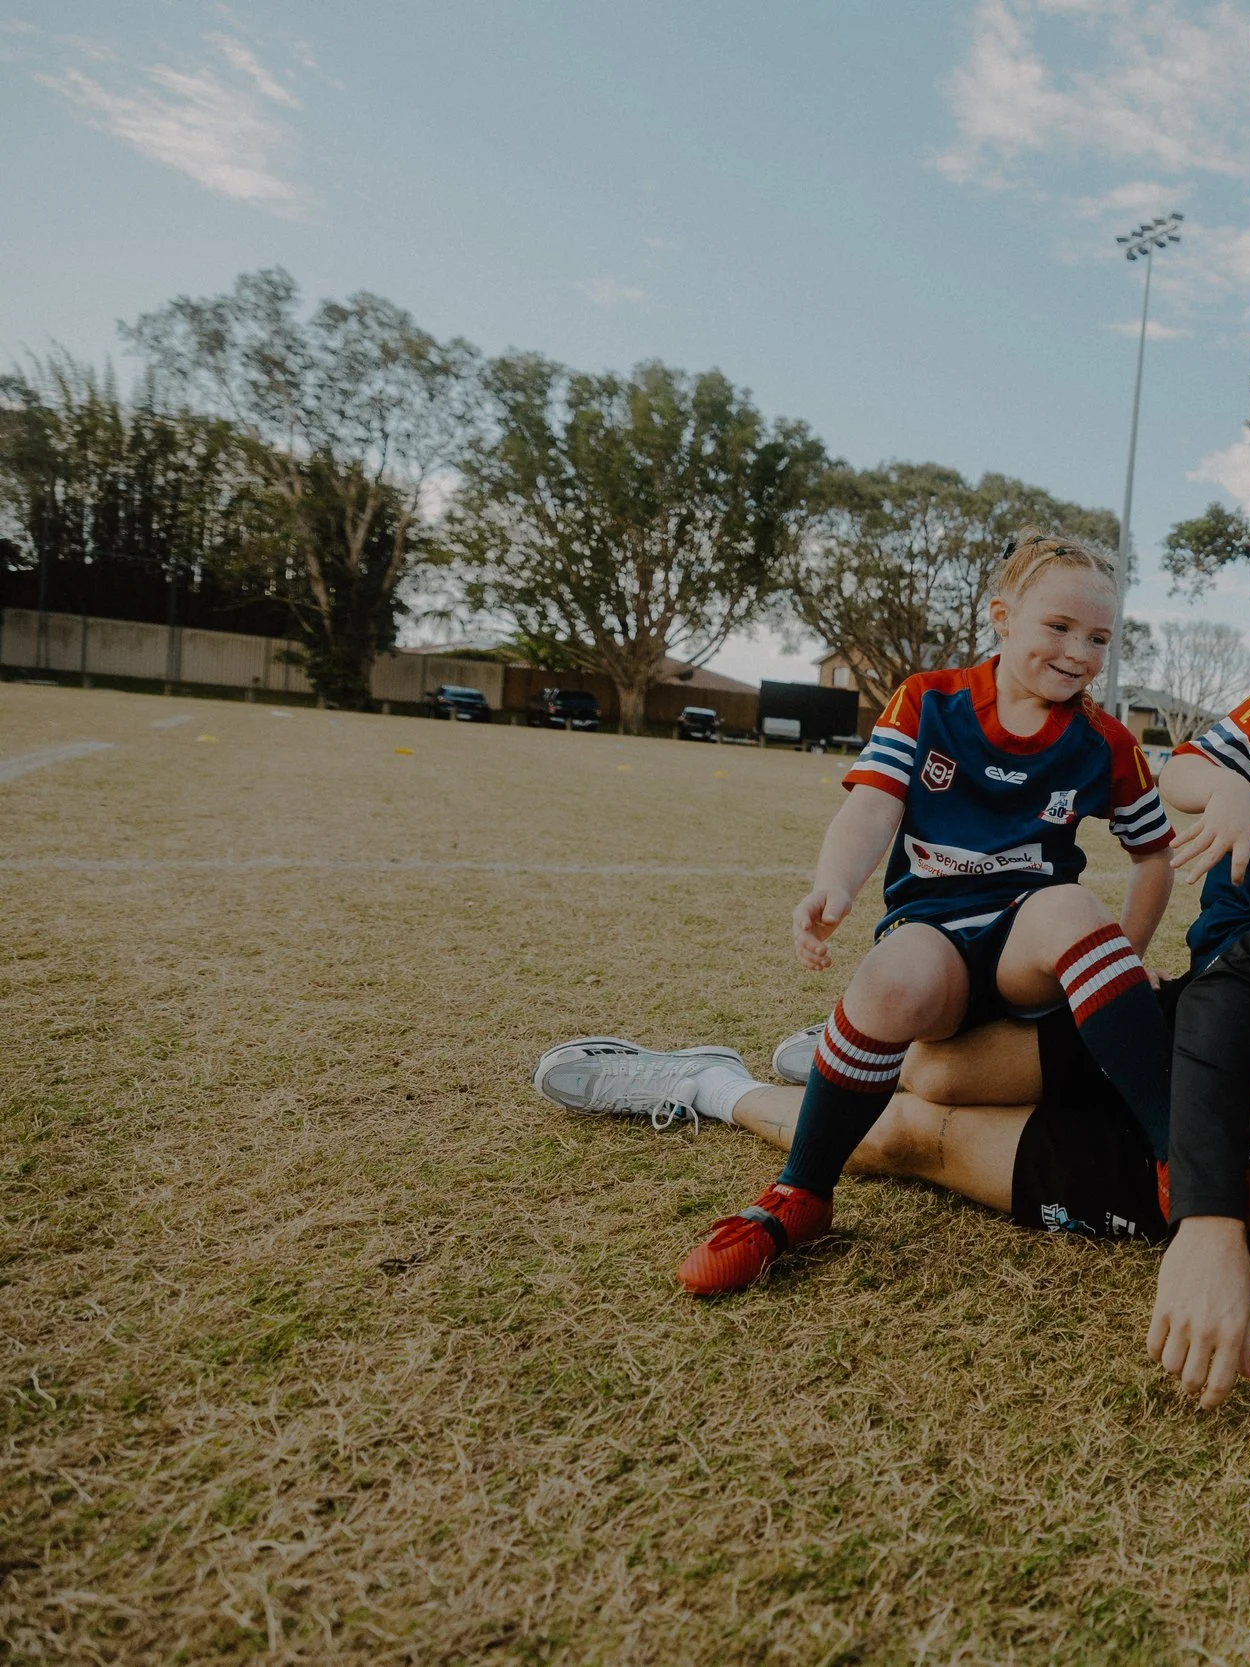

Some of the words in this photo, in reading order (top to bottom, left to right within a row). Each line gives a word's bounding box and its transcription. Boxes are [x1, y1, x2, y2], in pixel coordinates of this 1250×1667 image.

[1047, 806, 1065, 818] 50
[934, 851, 994, 875] Bendigo
[996, 853, 1032, 866] Bank
